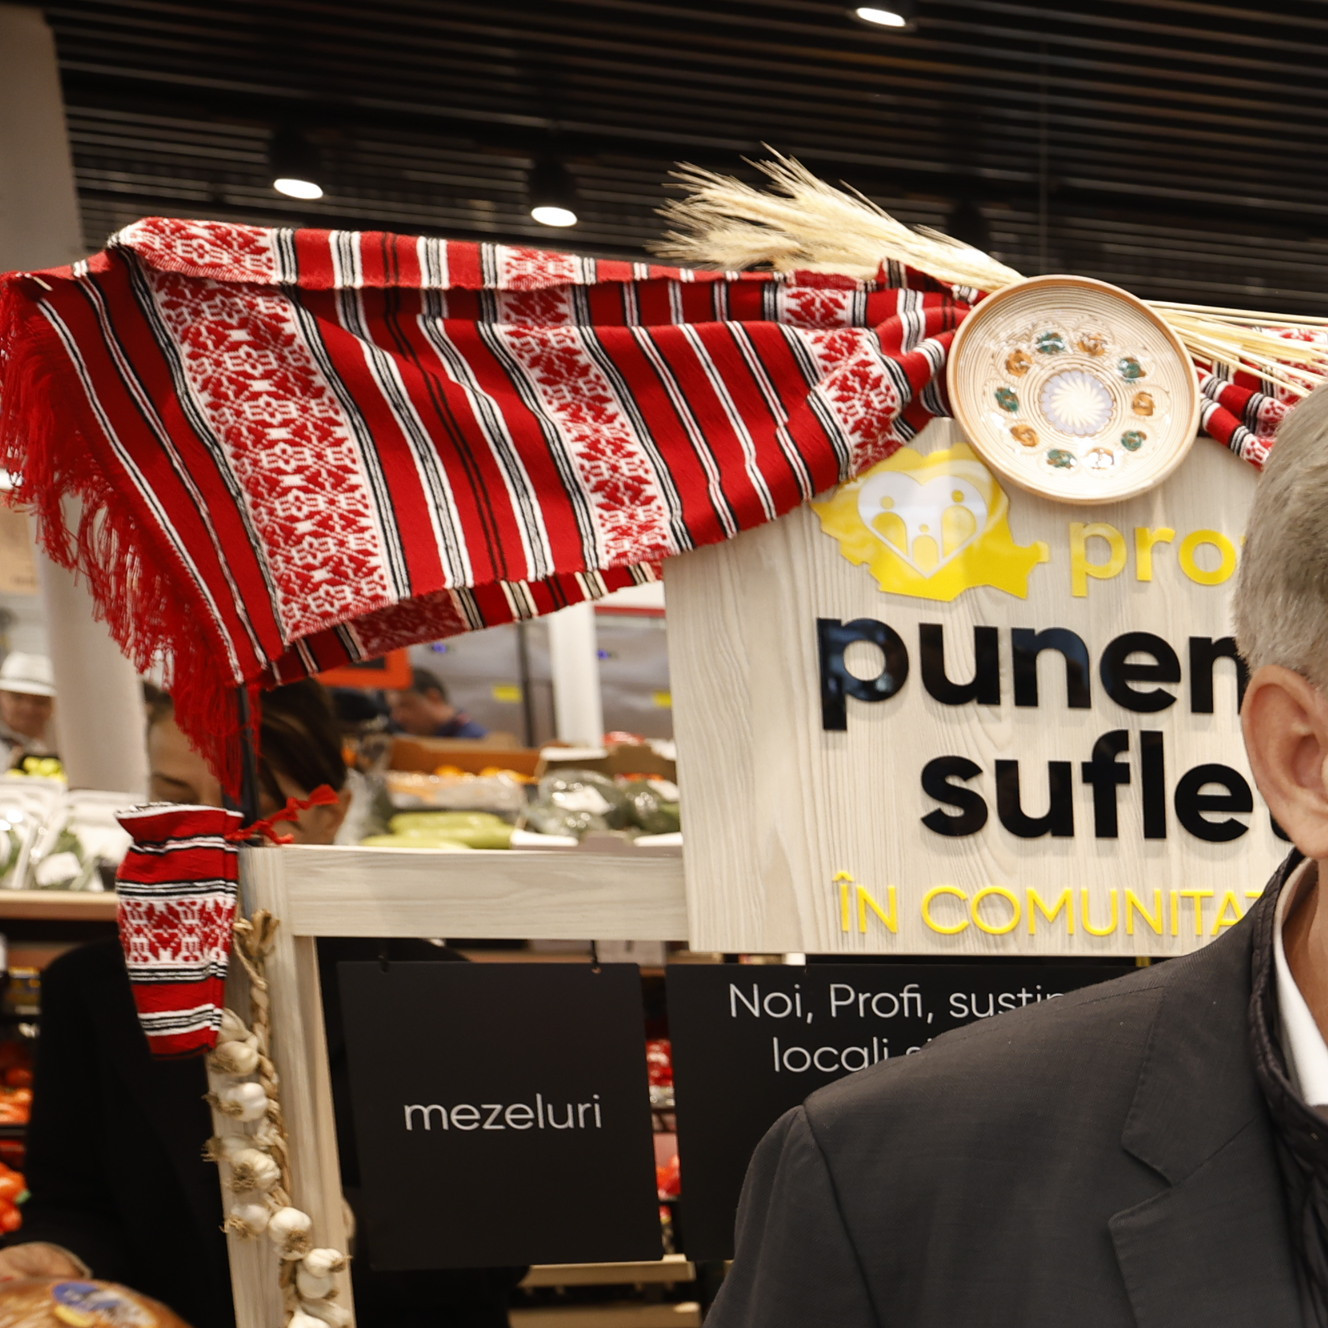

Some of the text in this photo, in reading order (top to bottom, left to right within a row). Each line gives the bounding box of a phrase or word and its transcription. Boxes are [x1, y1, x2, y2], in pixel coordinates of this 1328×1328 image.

[1068, 518, 1247, 598] pro
[920, 730, 1292, 843] sufle
[831, 871, 1263, 936] ÎN COMUNITA
[729, 982, 813, 1024] Noi,
[830, 982, 934, 1024] Profi,
[404, 1093, 601, 1131] mezeluri
